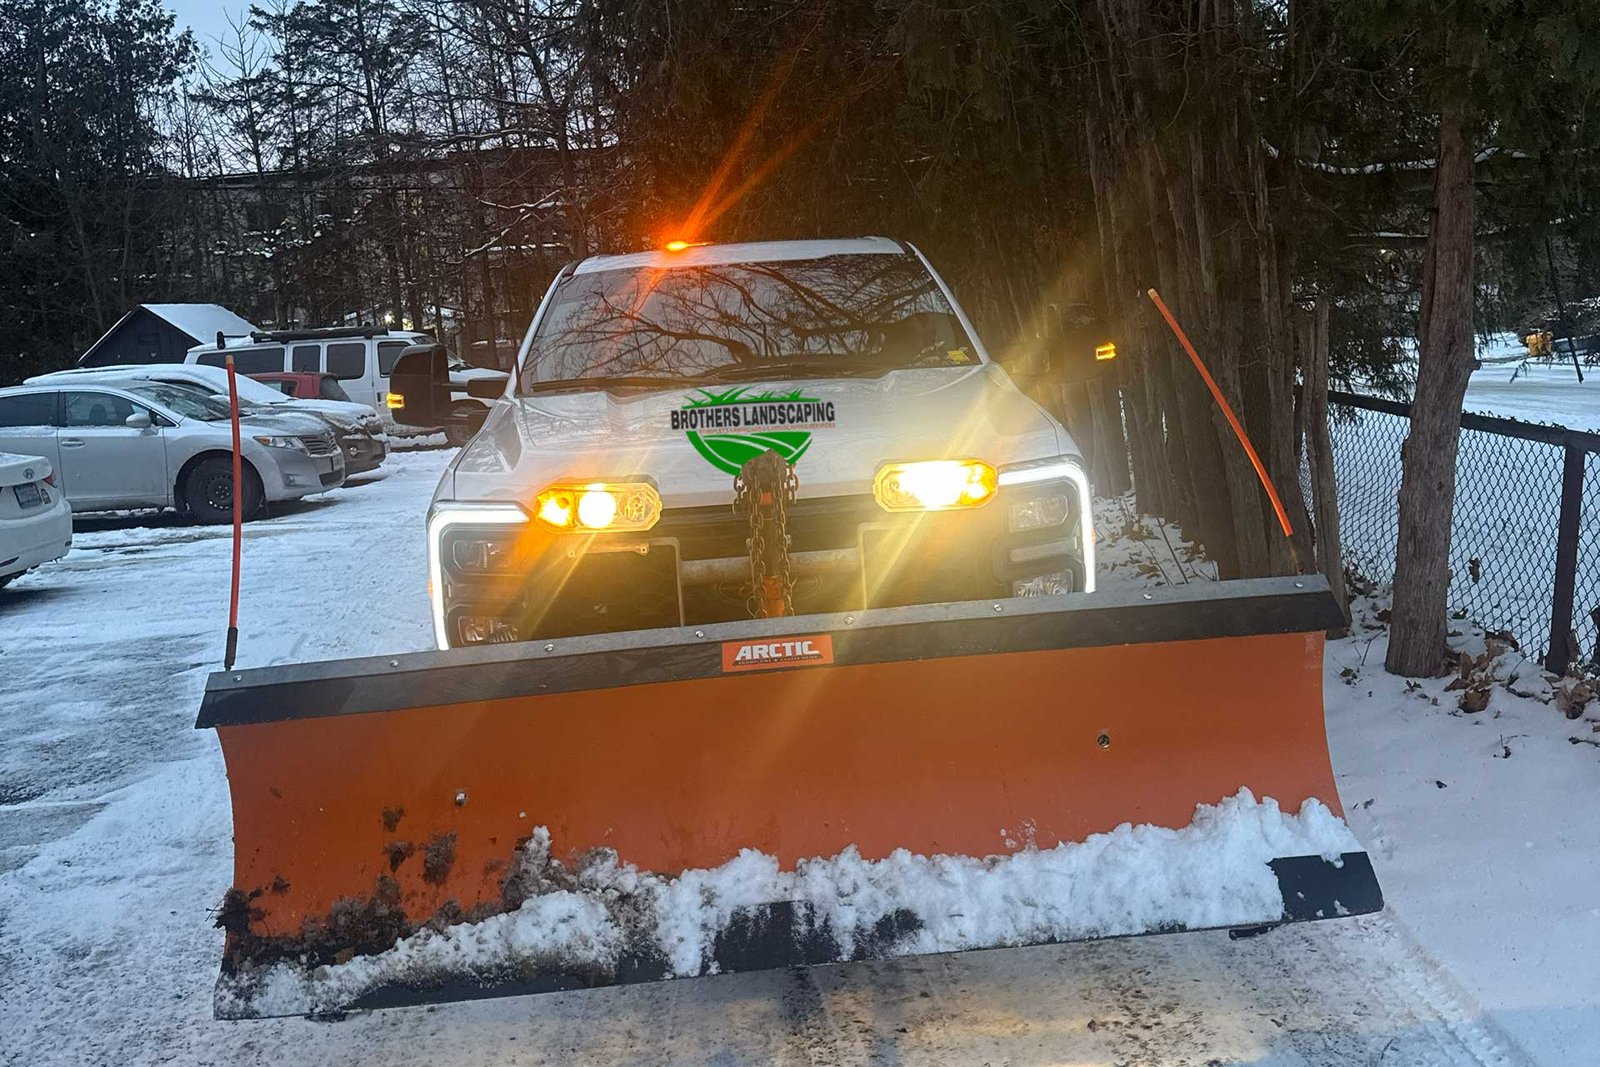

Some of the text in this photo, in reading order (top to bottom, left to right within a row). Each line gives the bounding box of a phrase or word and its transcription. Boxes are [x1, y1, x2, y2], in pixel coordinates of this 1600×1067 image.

[671, 406, 740, 430] BROTHERS
[743, 401, 835, 426] LANDSCAPING
[735, 640, 820, 660] ARCTIC
